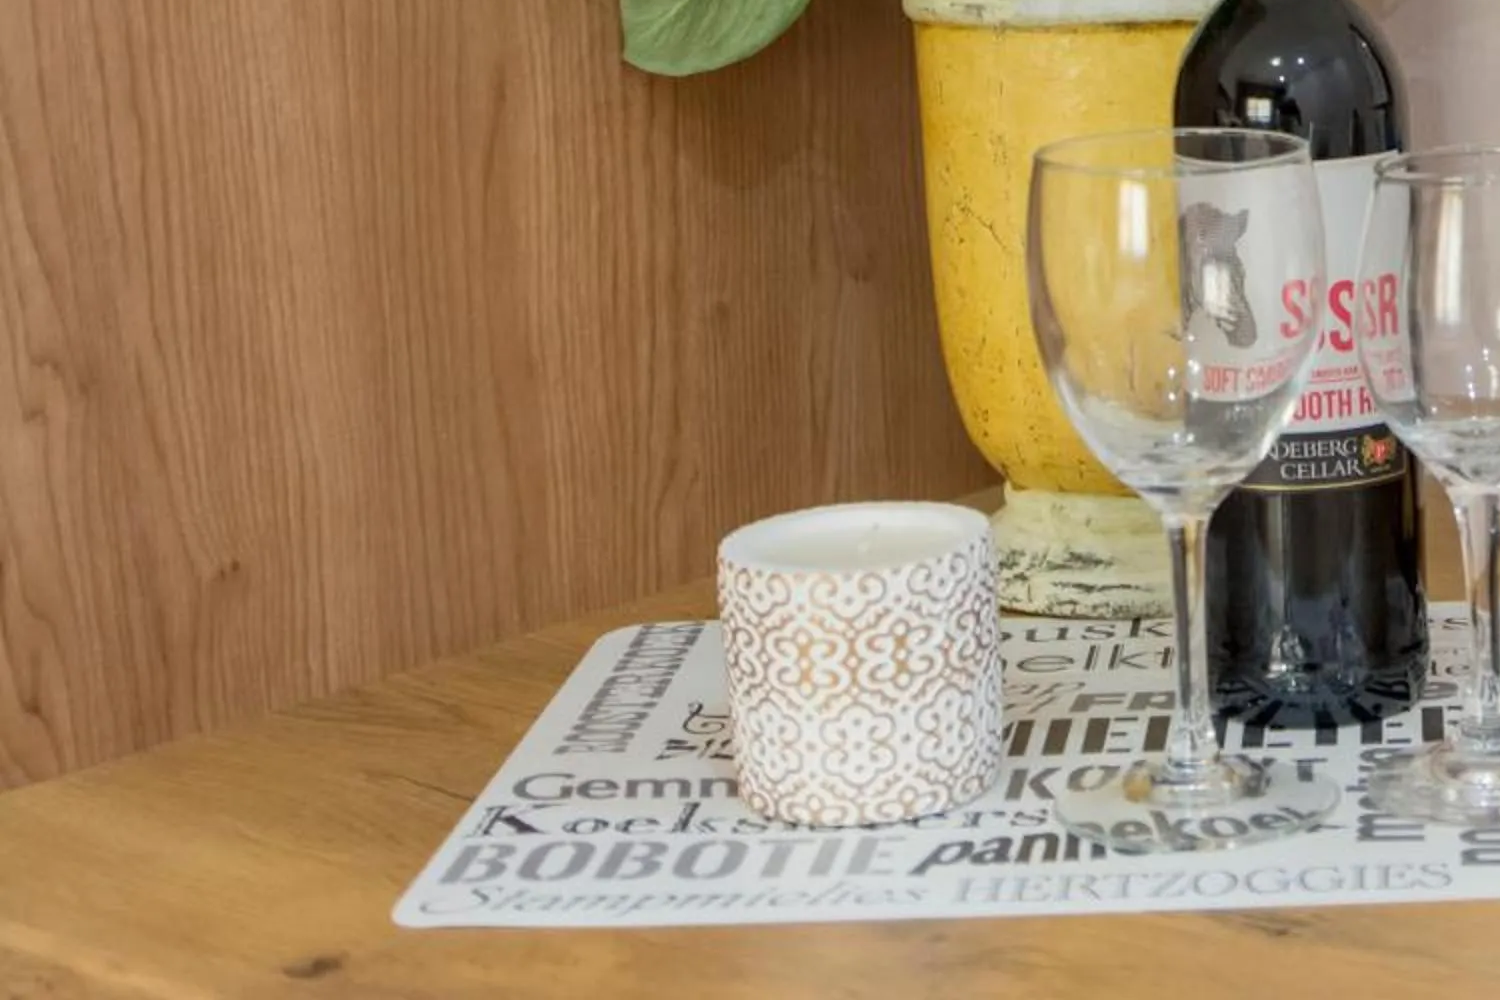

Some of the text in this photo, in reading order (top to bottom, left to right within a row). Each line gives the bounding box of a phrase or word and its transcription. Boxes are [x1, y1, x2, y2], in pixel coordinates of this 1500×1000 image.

[1267, 436, 1358, 460] DEBERG
[1279, 459, 1364, 481] CELLAR
[437, 835, 909, 885] BOBOTIE
[955, 862, 1454, 905] HERTZOGGIES
